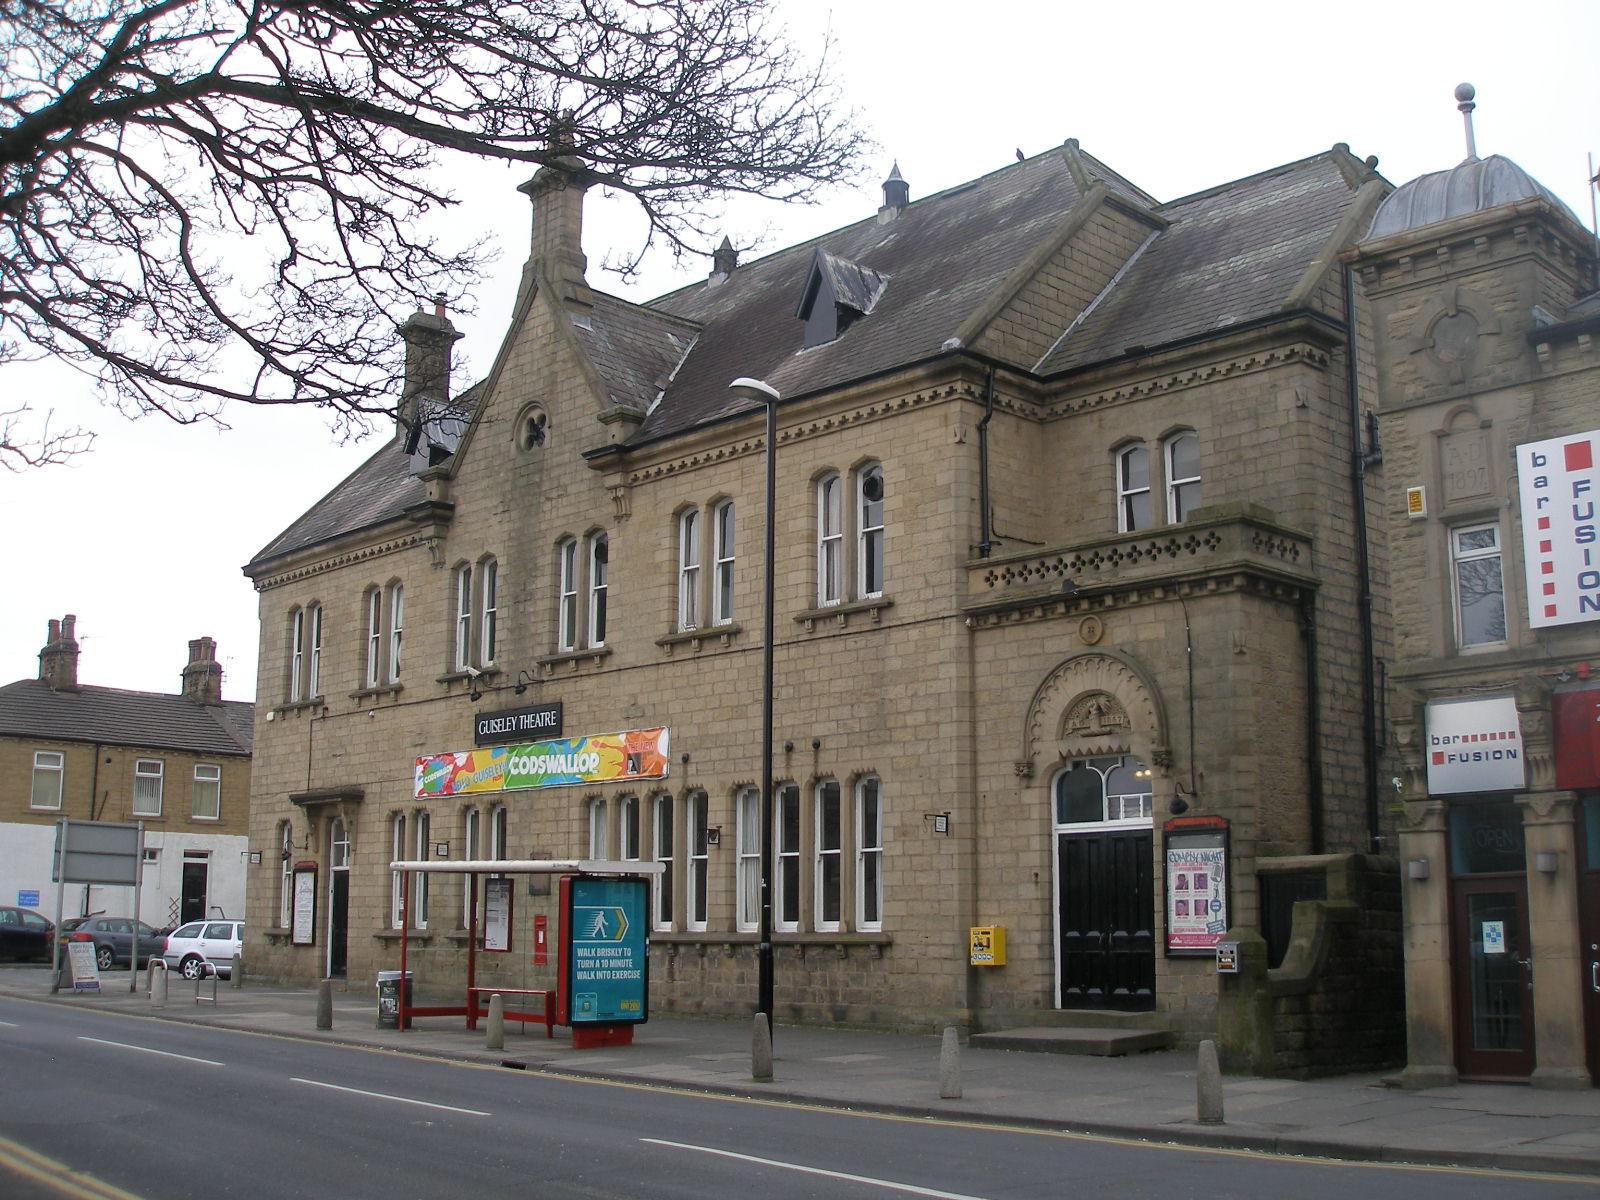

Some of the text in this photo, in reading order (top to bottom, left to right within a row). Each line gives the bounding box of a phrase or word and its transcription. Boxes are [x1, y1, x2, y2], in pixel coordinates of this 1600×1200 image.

[1531, 452, 1549, 509] bar
[1572, 479, 1600, 613] FUSION
[478, 711, 557, 735] GUISELEY THEATRE
[1431, 735, 1460, 745] bar
[628, 743, 639, 753] THE
[1448, 749, 1517, 764] FUSION
[509, 752, 600, 775] CODSWALLOP
[577, 947, 632, 957] WALK BRISKLY TO
[577, 958, 633, 968] TURN A 10 MINUTE
[577, 970, 641, 980] WALK INTO EXERCISE
